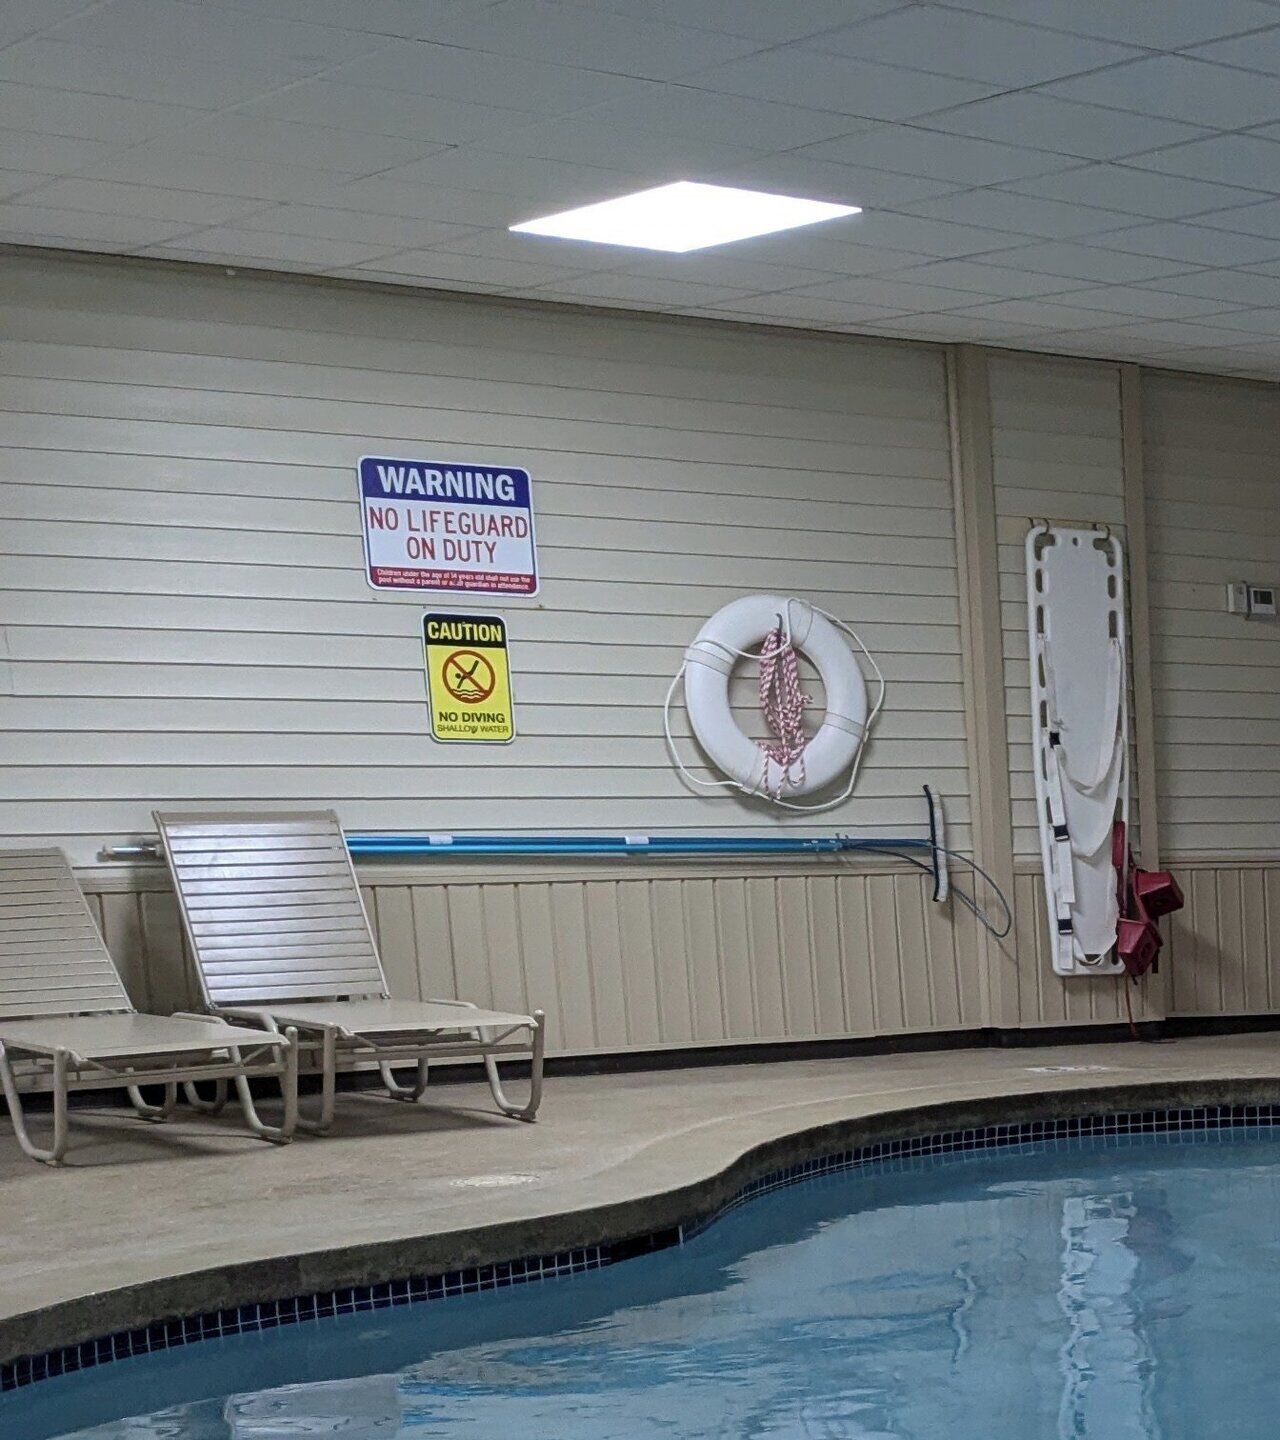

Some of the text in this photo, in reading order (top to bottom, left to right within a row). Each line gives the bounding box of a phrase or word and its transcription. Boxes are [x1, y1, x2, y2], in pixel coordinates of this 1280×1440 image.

[377, 465, 515, 501] WARNING
[369, 506, 528, 539] NO LIFEGUARD
[406, 536, 497, 564] ON DUTY
[377, 568, 401, 576] Children
[431, 572, 442, 580] age
[427, 620, 502, 643] CAUTION
[436, 724, 509, 734] SHALLOW WATER
[439, 711, 505, 724] NO DIVING
